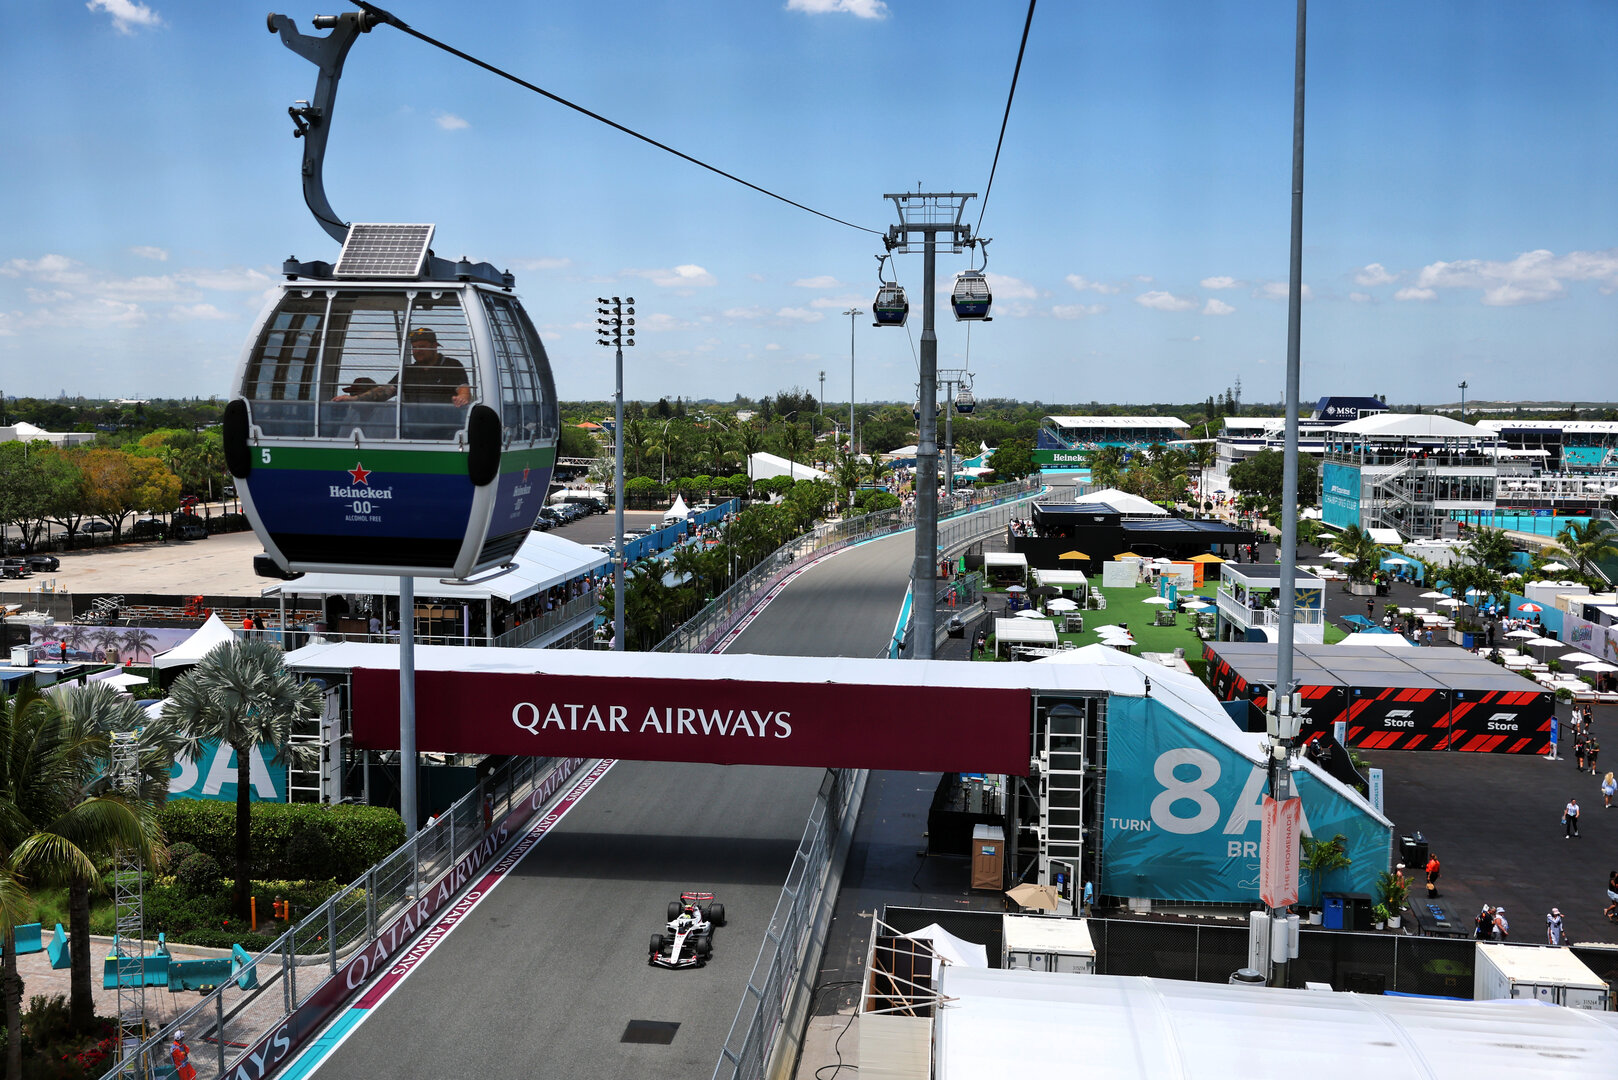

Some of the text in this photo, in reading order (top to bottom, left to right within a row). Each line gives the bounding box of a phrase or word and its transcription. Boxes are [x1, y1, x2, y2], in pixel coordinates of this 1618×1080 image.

[262, 448, 271, 464] 5
[1053, 453, 1089, 462] Heineke
[329, 486, 392, 499] Heineken
[353, 500, 371, 514] 0.0
[512, 702, 792, 738] QATAR AIRWAYS
[1384, 718, 1414, 727] Store
[1487, 721, 1518, 731] Store
[532, 759, 571, 810] QATAR
[1110, 817, 1151, 831] TURN
[495, 814, 558, 873] QATAR AIRWAYS
[346, 820, 508, 990] QATAR AIRWAYS
[391, 891, 482, 975] QATAR AIRWAYS
